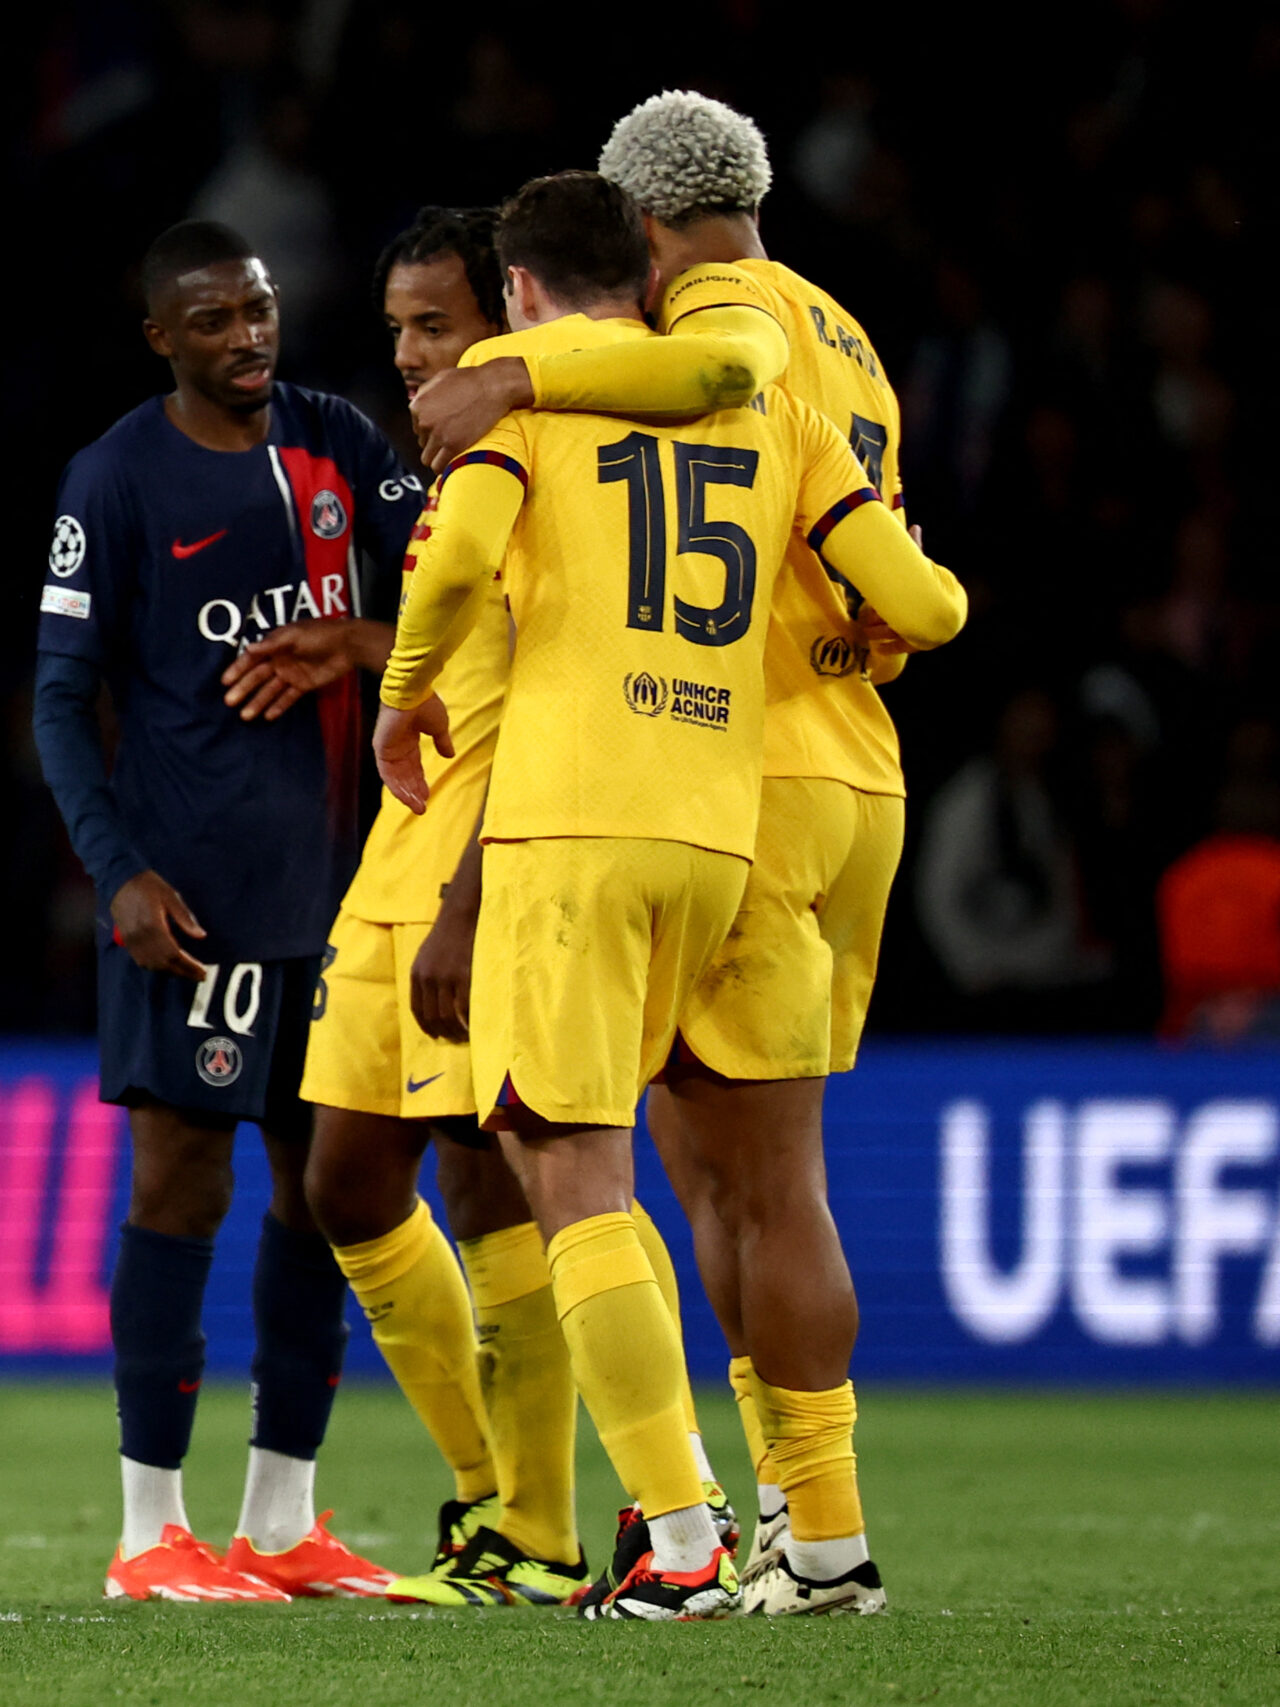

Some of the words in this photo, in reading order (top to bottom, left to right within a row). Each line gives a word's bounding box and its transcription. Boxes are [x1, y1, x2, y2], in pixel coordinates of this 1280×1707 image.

[597, 431, 759, 647] 15
[197, 573, 347, 647] QATAR
[671, 697, 729, 724] ACNUR
[672, 678, 731, 706] UNHCR
[186, 962, 262, 1037] 10
